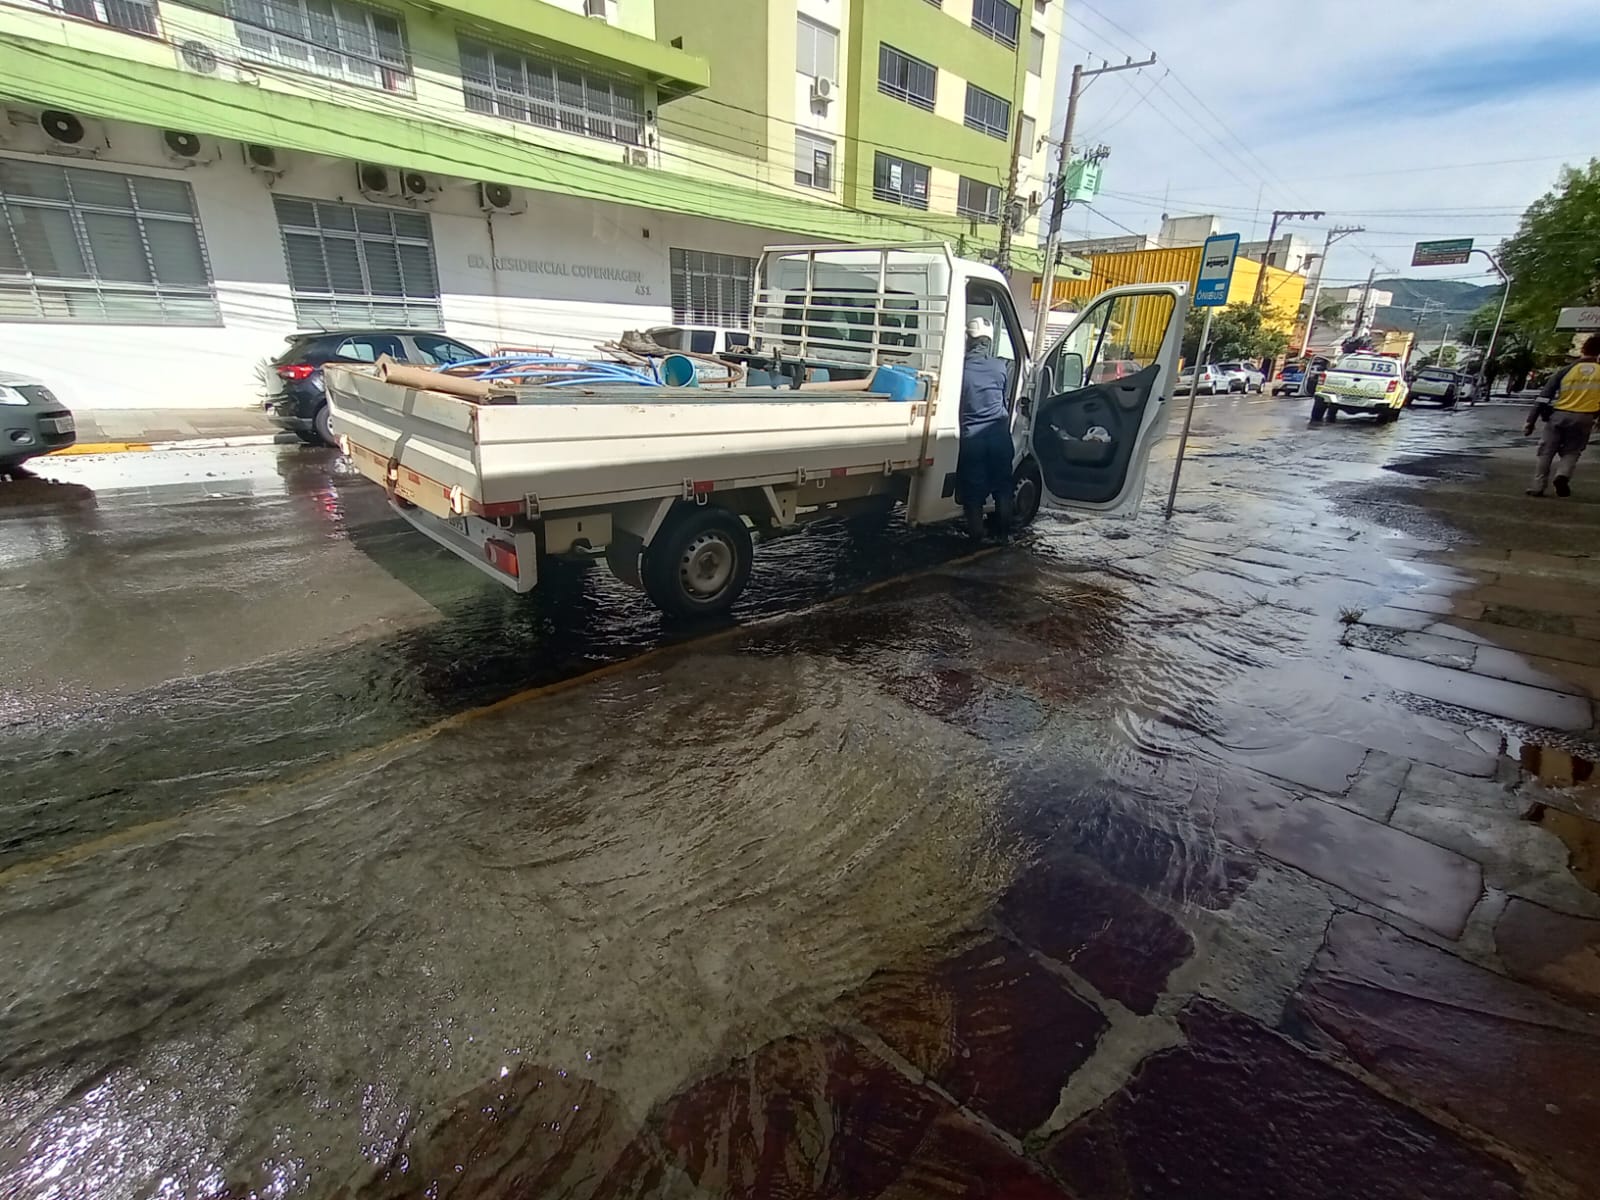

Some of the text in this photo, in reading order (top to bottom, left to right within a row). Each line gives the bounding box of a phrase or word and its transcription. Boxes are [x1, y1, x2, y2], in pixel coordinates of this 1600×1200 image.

[467, 255, 641, 282] ED. RESIDENCIAL COPENHAGEN
[635, 286, 652, 295] 431
[1370, 362, 1392, 373] 153
